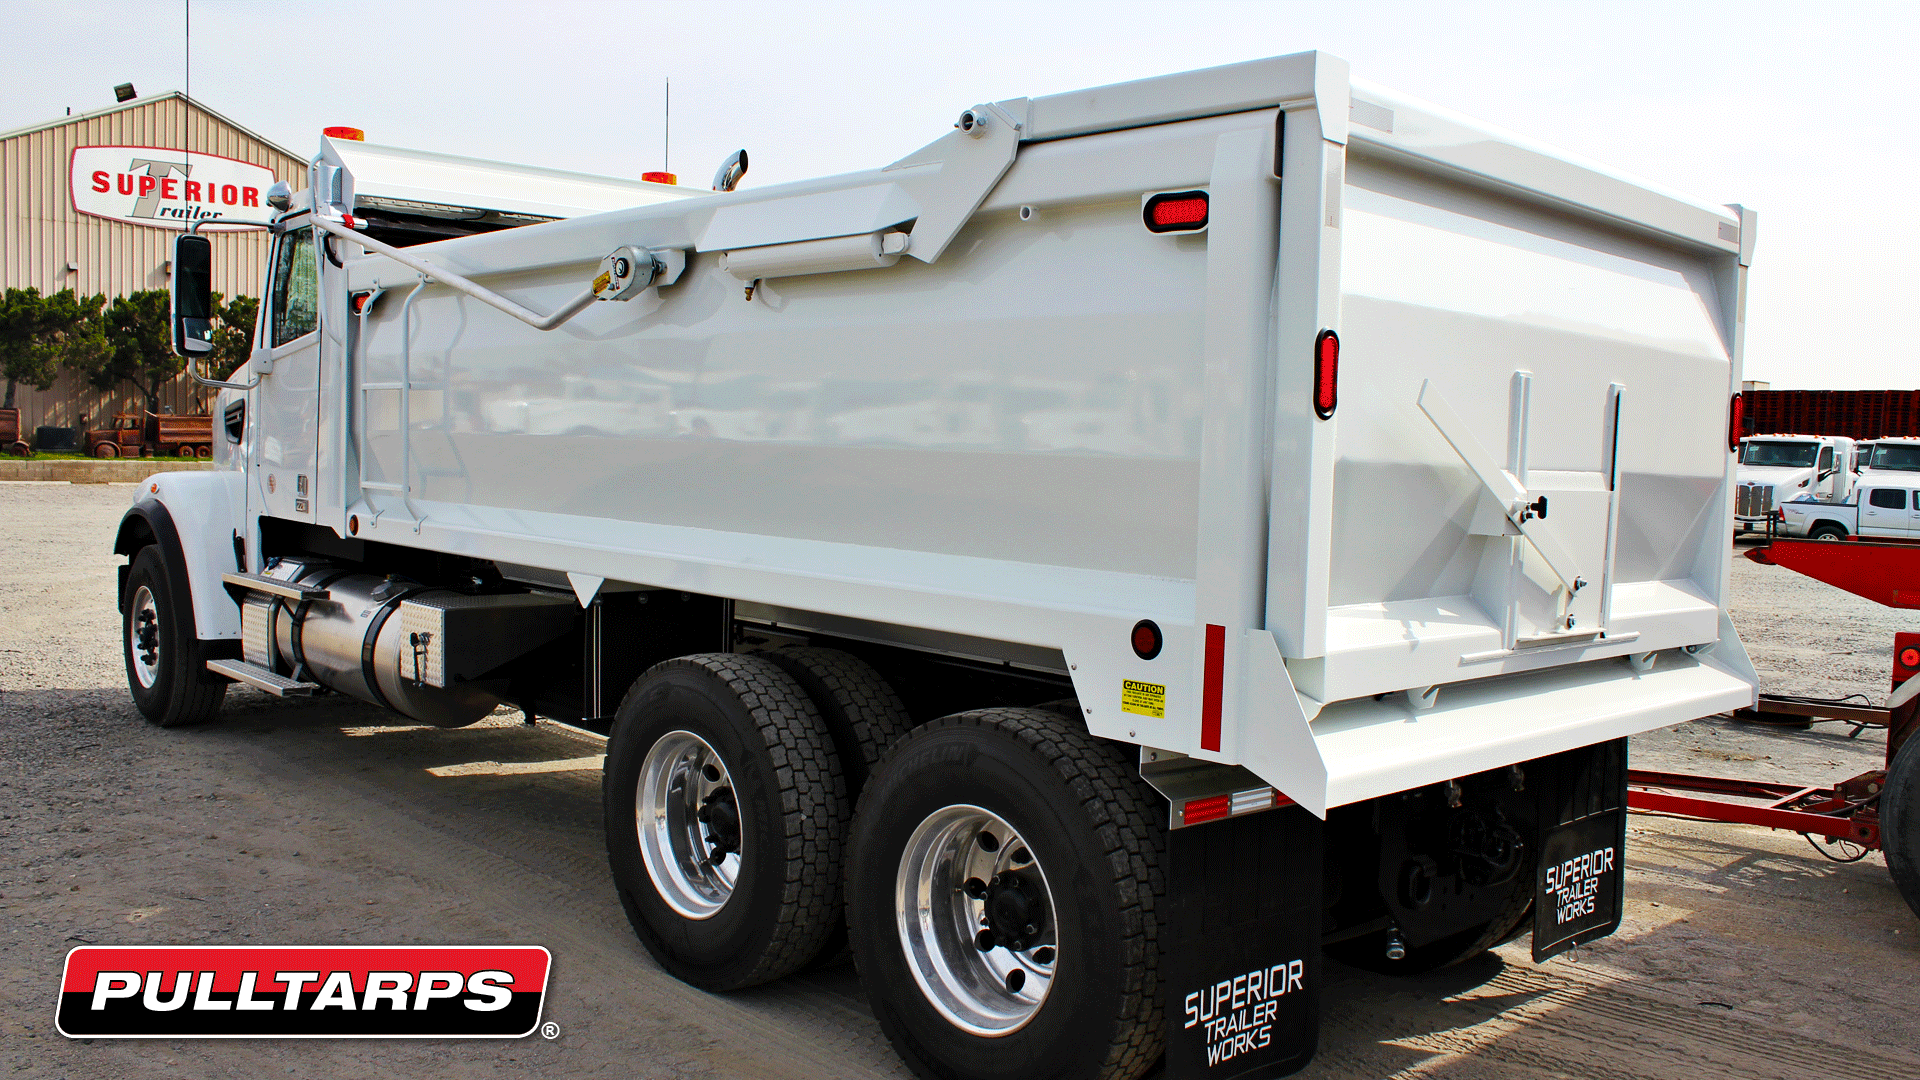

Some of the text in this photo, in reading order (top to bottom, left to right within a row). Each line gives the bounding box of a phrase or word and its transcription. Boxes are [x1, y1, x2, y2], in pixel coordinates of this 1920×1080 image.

[92, 171, 259, 208] SUPERIOR
[1125, 681, 1164, 694] CAUTION
[1545, 847, 1614, 894] SUPERIOR
[1557, 877, 1598, 907] TRAILER
[1557, 895, 1595, 925] WORKS
[1184, 959, 1303, 1029] SUPERIOR
[1204, 1000, 1277, 1044] TRAILER
[1207, 1025, 1272, 1067] WORKS
